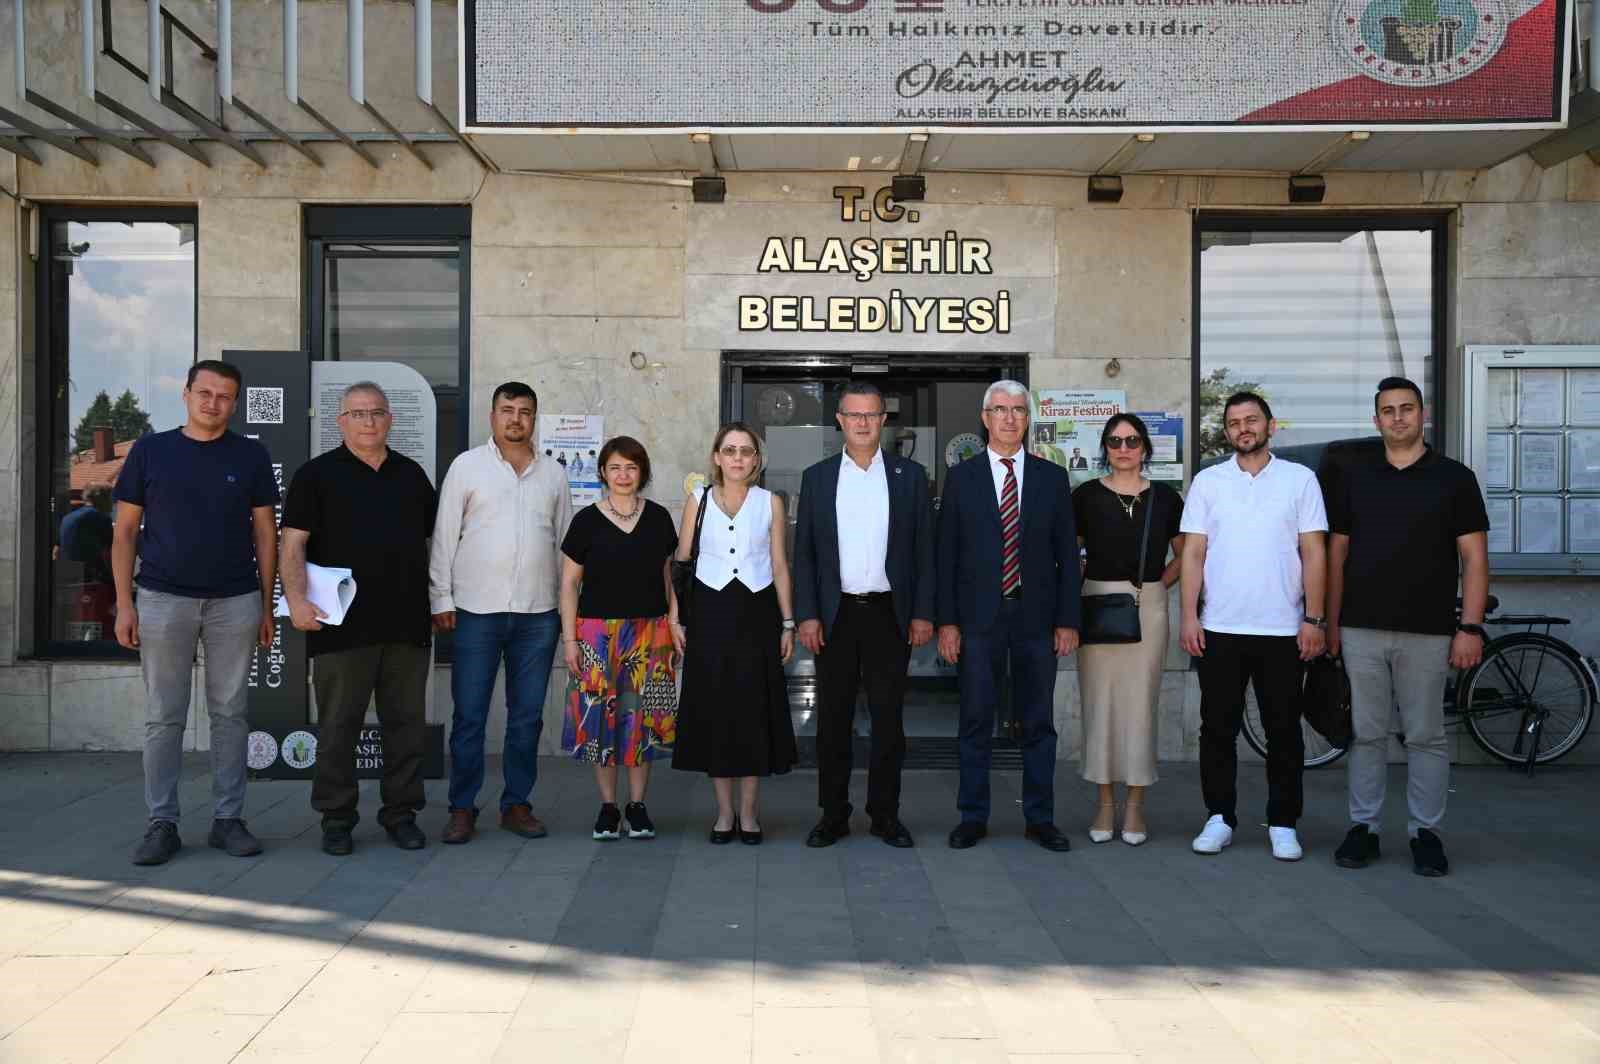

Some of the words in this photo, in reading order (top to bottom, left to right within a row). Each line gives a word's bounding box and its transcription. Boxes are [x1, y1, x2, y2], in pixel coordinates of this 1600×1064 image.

[808, 21, 870, 37] Tüm
[888, 21, 1026, 37] Halkımız
[1044, 19, 1217, 37] Davetlidir.
[954, 50, 1067, 68] AHMET
[896, 105, 973, 119] ALAŞEHİR
[978, 105, 1050, 119] BELEDİYE
[1057, 107, 1127, 119] BAŞKANI
[833, 186, 920, 222] T.C.
[757, 230, 993, 282] ALAŞEHİR
[738, 288, 1011, 334] BELEDİYESİ
[1040, 406, 1071, 417] Kiraz
[1073, 404, 1120, 416] Festivali
